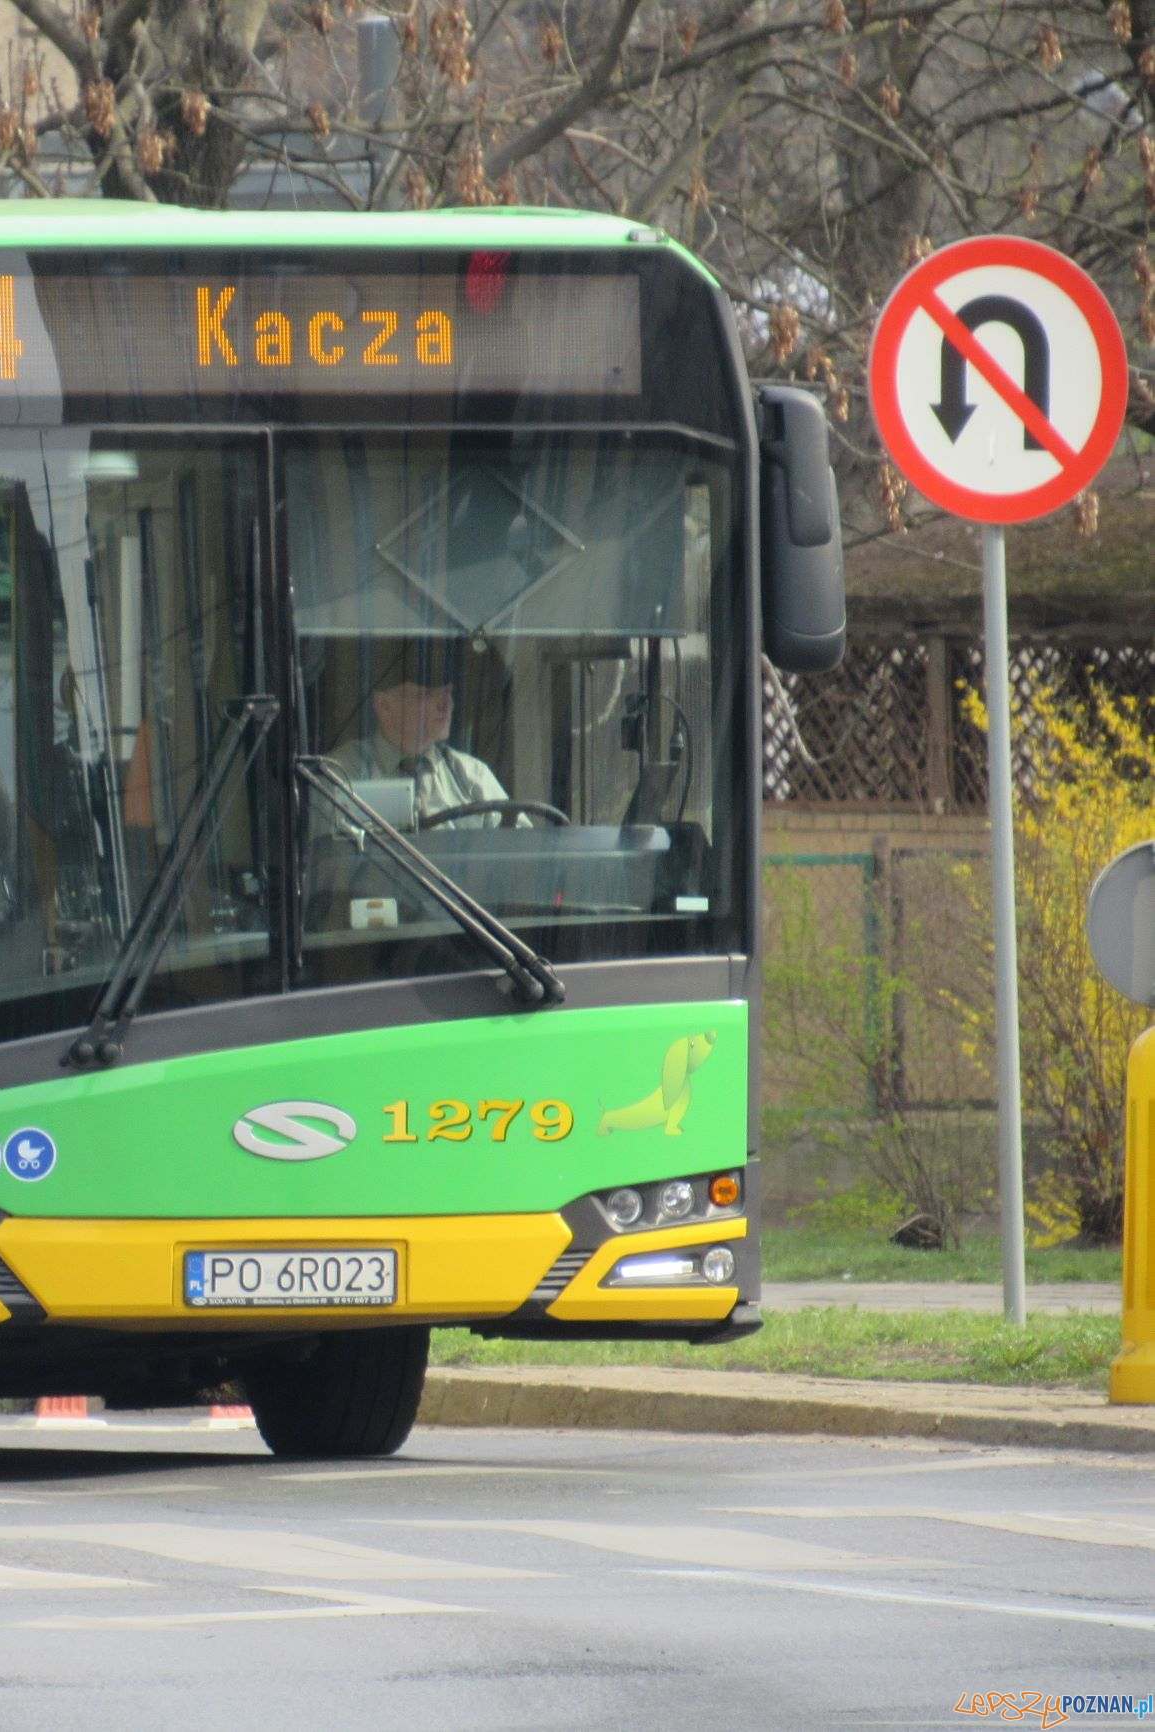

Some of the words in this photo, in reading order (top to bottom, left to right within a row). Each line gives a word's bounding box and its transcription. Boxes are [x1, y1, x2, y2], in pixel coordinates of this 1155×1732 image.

[196, 286, 453, 367] Kacza
[382, 1099, 574, 1143] 1279
[190, 1280, 203, 1292] PL
[210, 1257, 262, 1293] PO
[277, 1257, 386, 1293] 6R023
